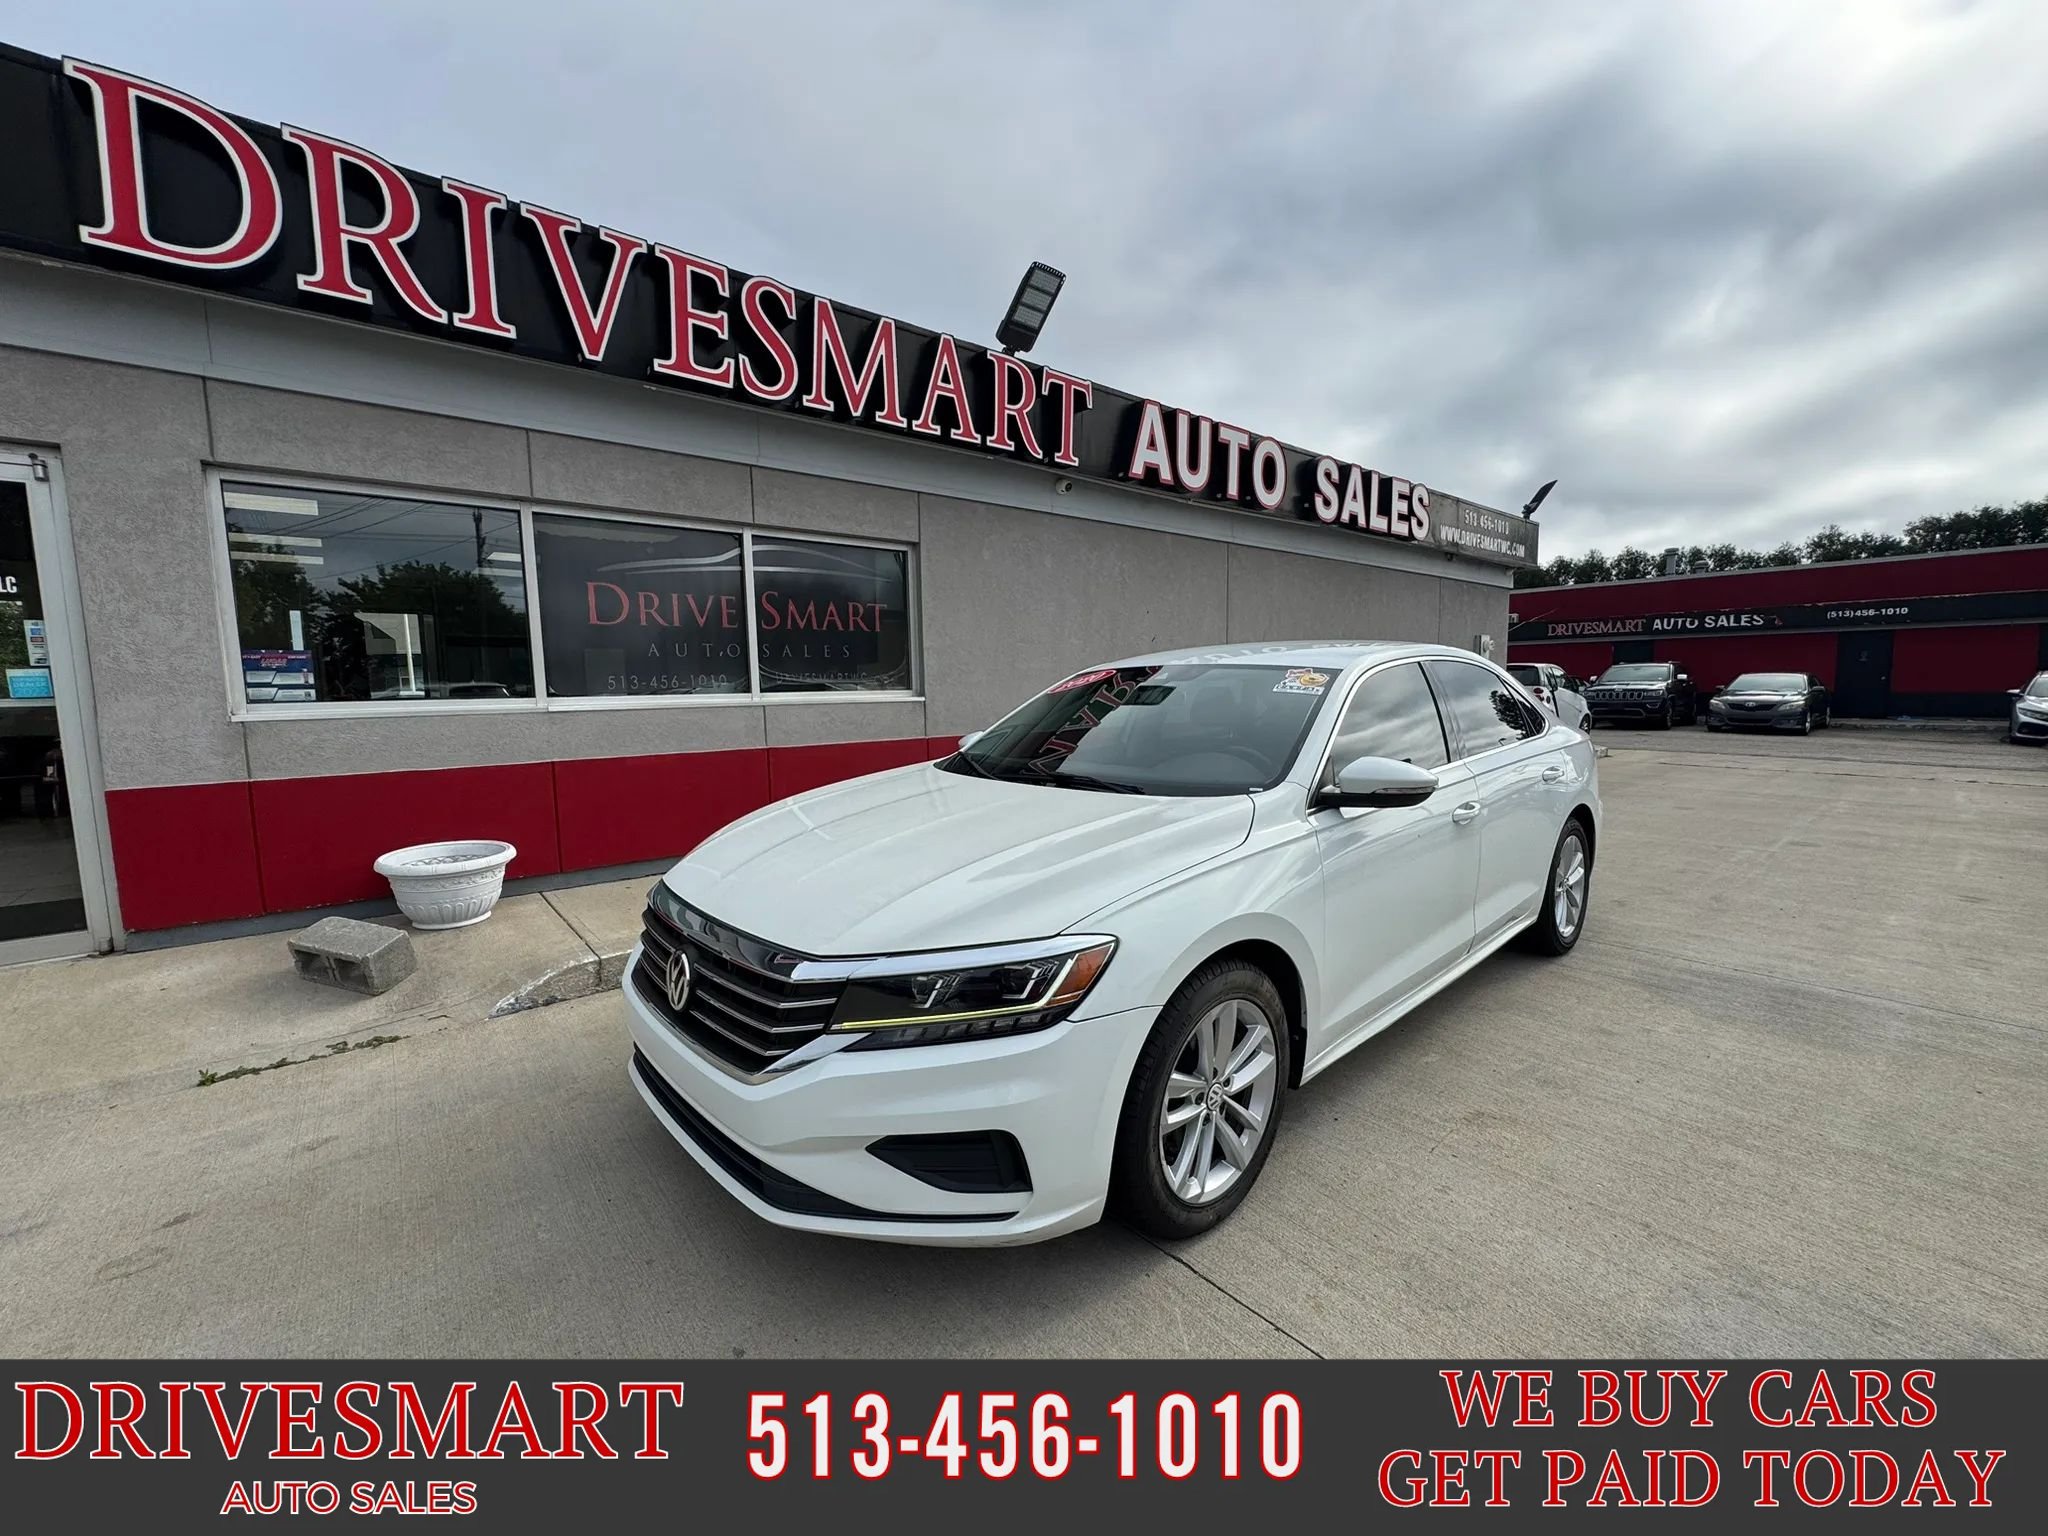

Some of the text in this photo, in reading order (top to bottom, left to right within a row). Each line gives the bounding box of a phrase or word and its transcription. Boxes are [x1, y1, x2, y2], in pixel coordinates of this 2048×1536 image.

[62, 56, 1431, 542] DRIVESMART AUTO SALES
[1547, 613, 1764, 637] DRIVESMART AUTO SALES
[647, 642, 850, 659] AUTO SALES
[607, 674, 728, 690] 513-456-1010
